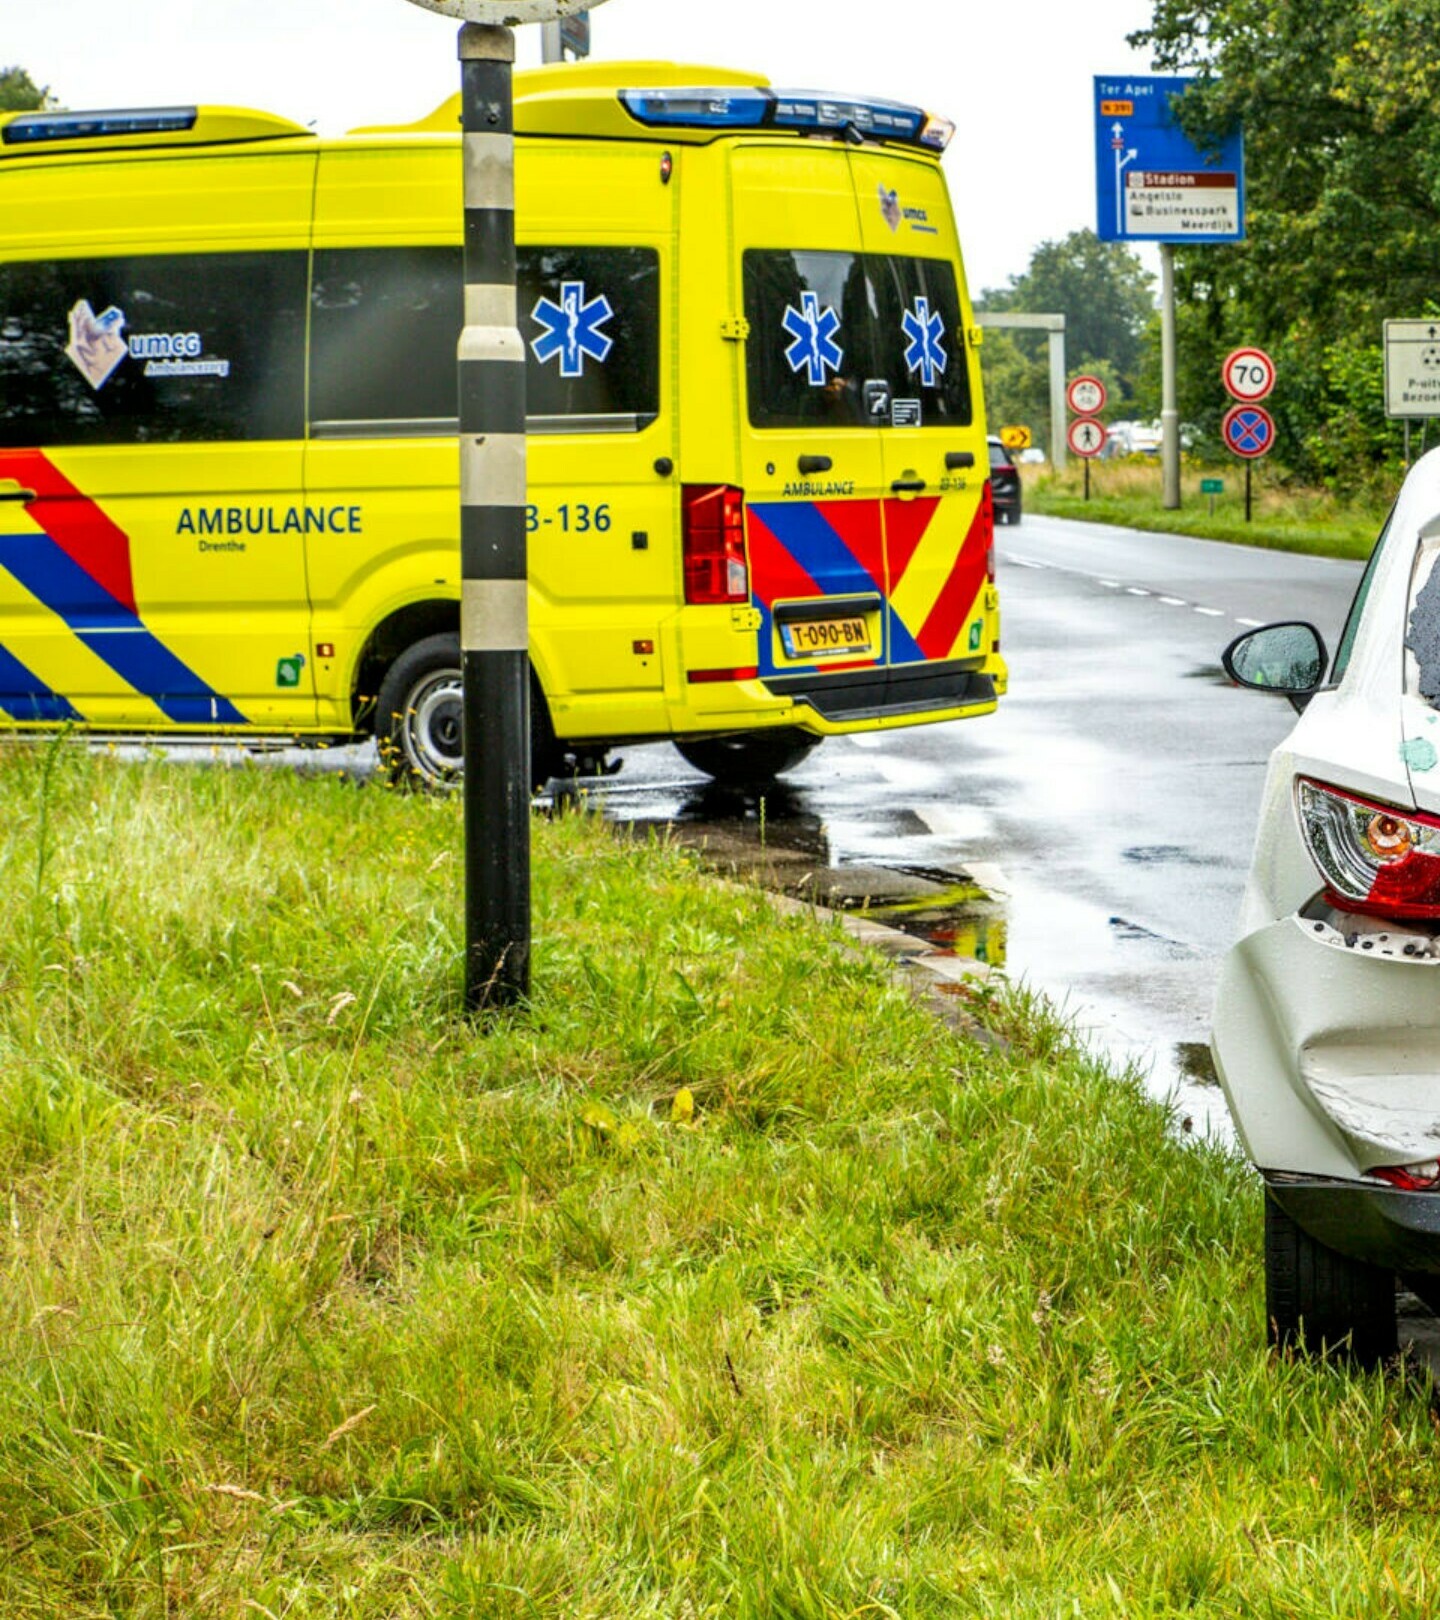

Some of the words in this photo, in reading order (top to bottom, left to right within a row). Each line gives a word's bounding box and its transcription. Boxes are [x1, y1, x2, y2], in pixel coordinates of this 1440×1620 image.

[1101, 84, 1120, 94] Ter
[1125, 84, 1153, 96] Apel
[1146, 174, 1195, 185] Stadion
[1130, 192, 1182, 202] Angelslo
[1147, 206, 1227, 217] Businesspark
[1182, 221, 1233, 232] Meerdijk
[1234, 365, 1265, 385] 70
[783, 481, 854, 496] AMBULANCE
[176, 506, 362, 534] AMBULANCE
[526, 504, 611, 532] 3-136
[198, 540, 246, 552] Drenthe
[793, 621, 865, 647] T-090-BN
